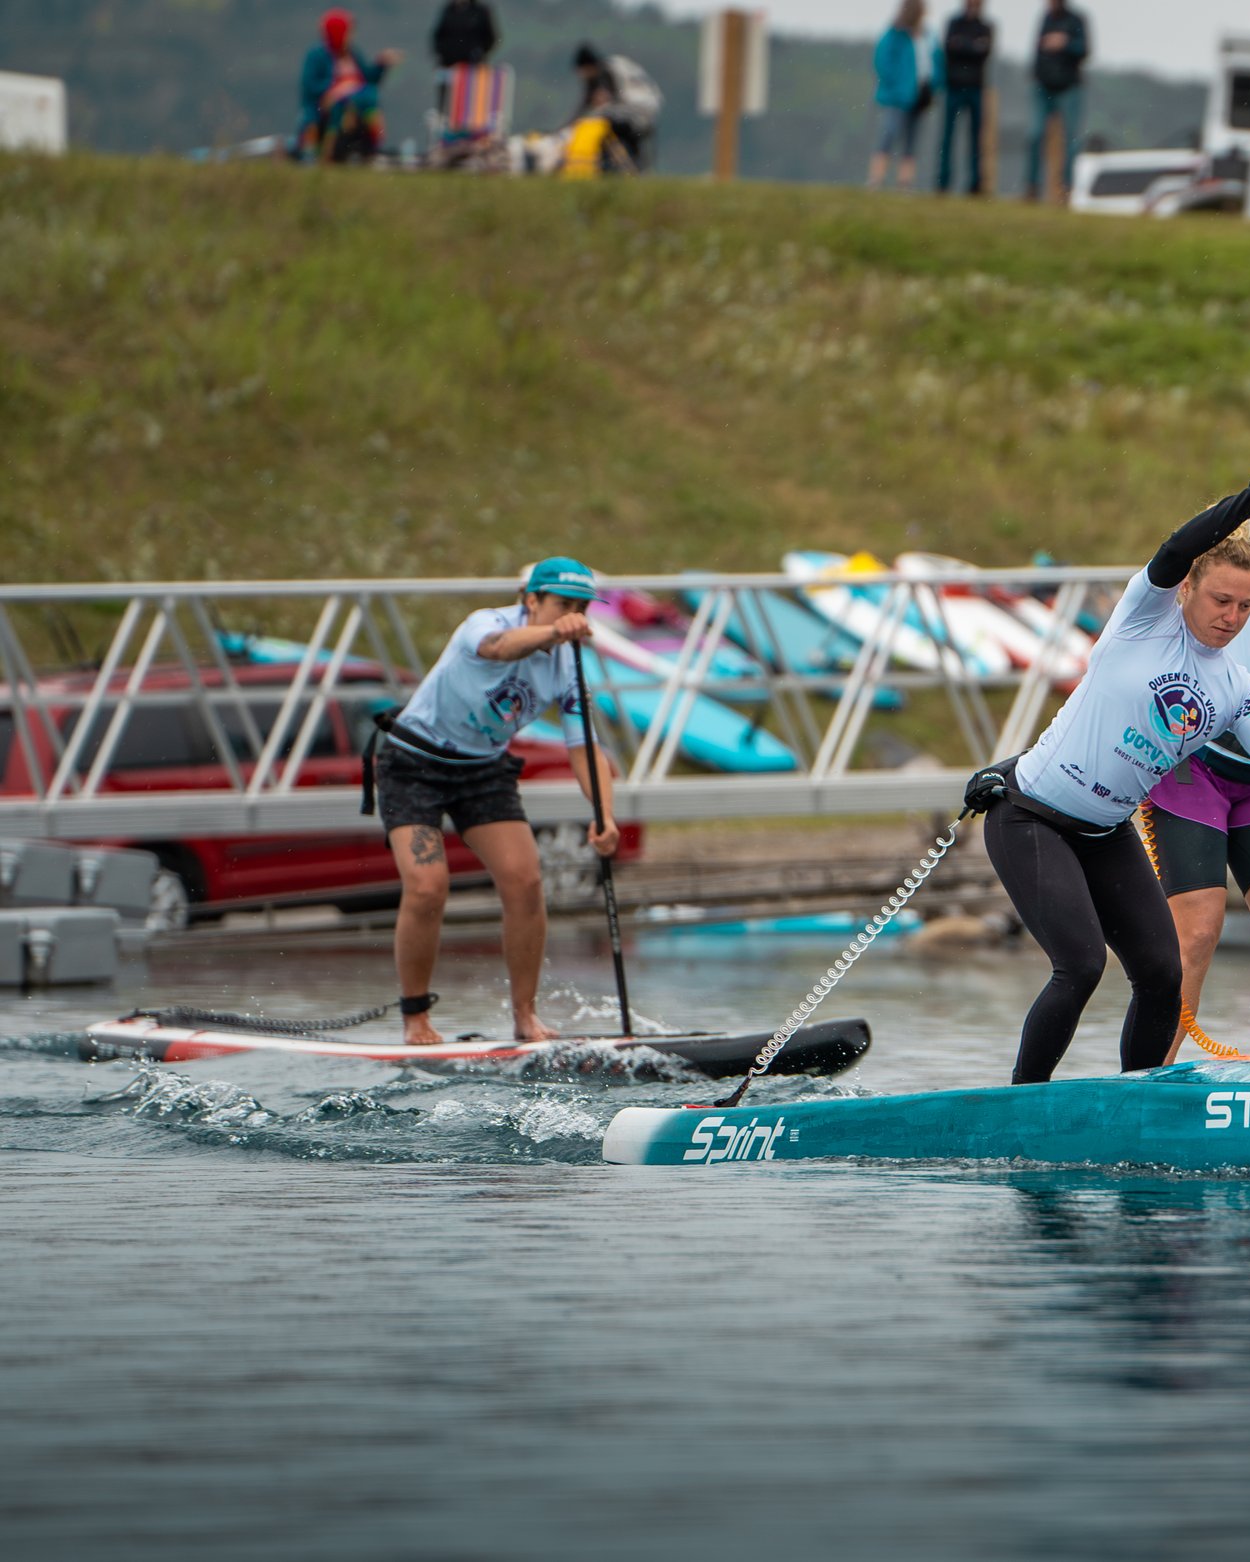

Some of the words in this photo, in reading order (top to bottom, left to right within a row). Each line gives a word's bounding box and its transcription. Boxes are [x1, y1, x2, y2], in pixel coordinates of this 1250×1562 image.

[1148, 672, 1181, 691] QUEEN
[1204, 699, 1217, 738] VALLEY
[1113, 746, 1132, 762] GHOST
[1122, 726, 1162, 761] QOTV
[1091, 781, 1112, 799] NSP
[683, 1116, 786, 1165] Sprint
